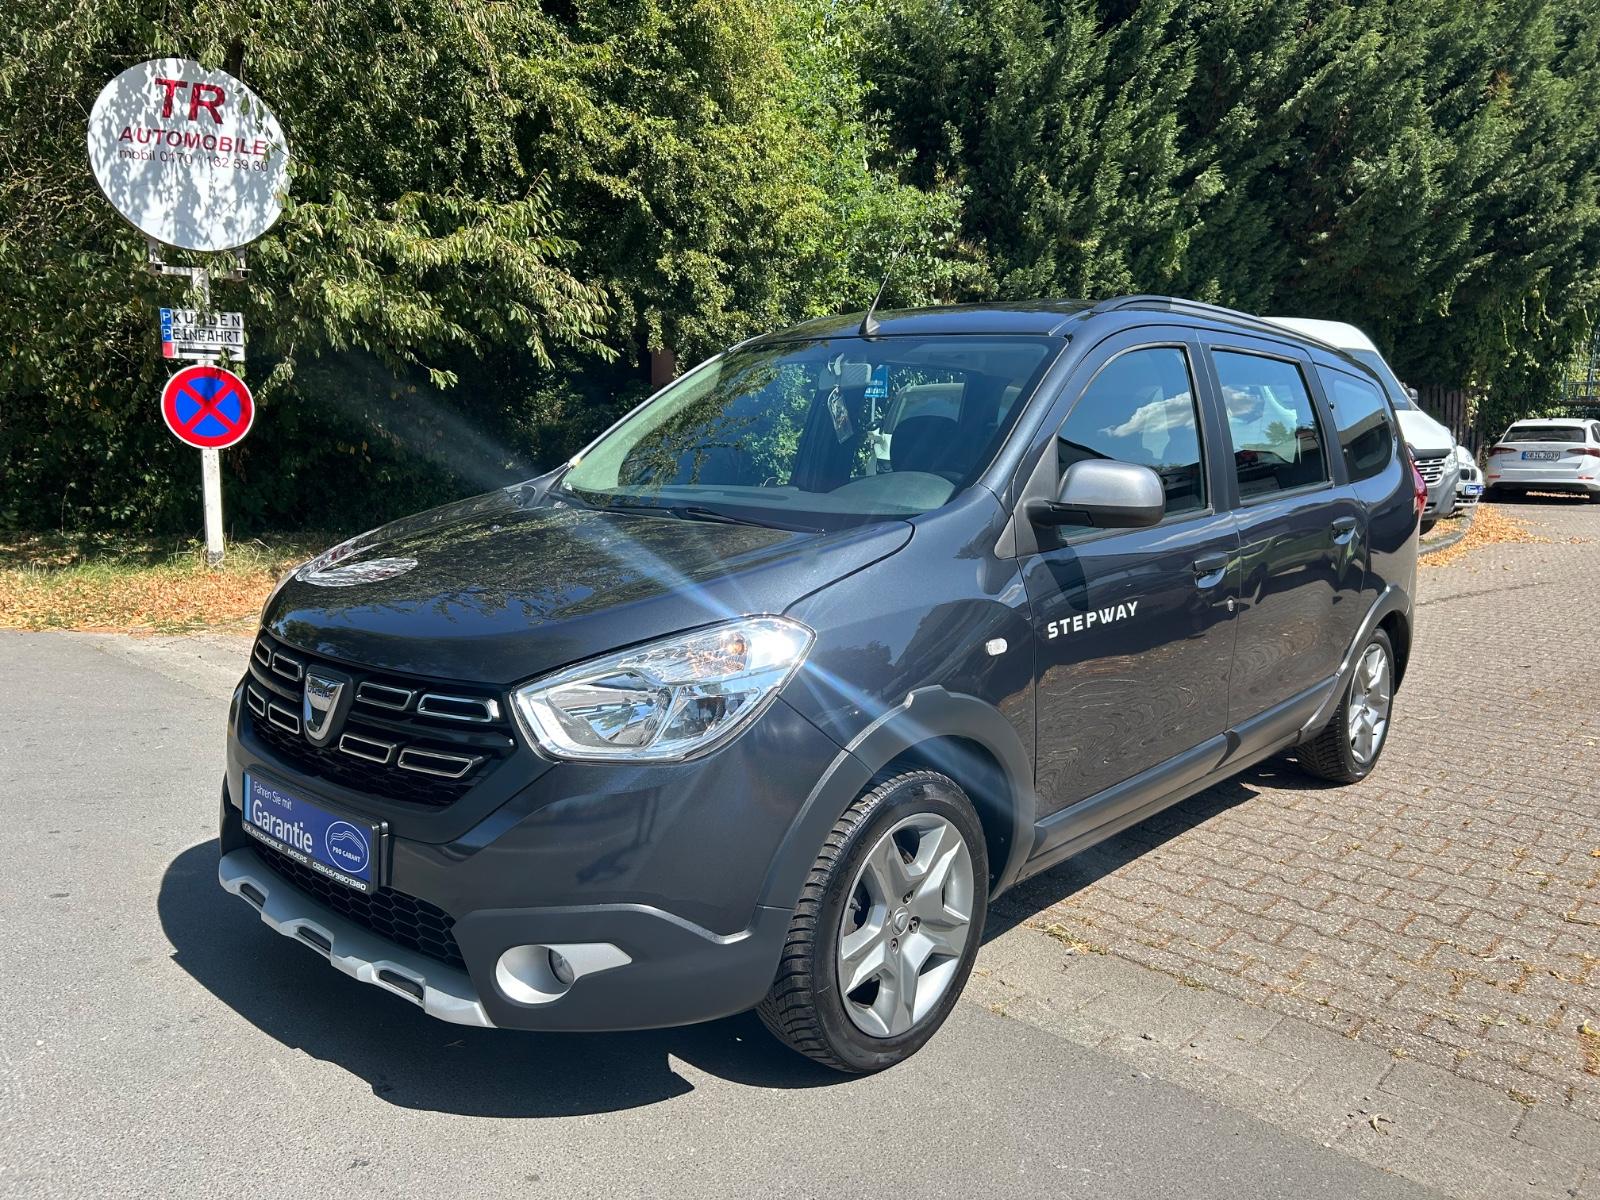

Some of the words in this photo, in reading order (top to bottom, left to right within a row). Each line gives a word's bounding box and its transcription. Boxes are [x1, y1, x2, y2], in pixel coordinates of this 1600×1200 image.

[155, 78, 226, 124] TR
[119, 127, 267, 156] AUTOMOBILE
[119, 149, 156, 161] mobil
[160, 151, 193, 165] 0170
[233, 158, 249, 171] 59
[253, 160, 269, 172] 30
[173, 328, 241, 343] EINFAHRT
[1047, 601, 1138, 639] STEPWAY
[254, 781, 272, 800] Fahren
[272, 791, 281, 805] Sie
[282, 798, 292, 811] mit
[252, 799, 313, 854] Garantie
[251, 829, 283, 851] AUTOMOBILE
[287, 848, 308, 864] MOERS
